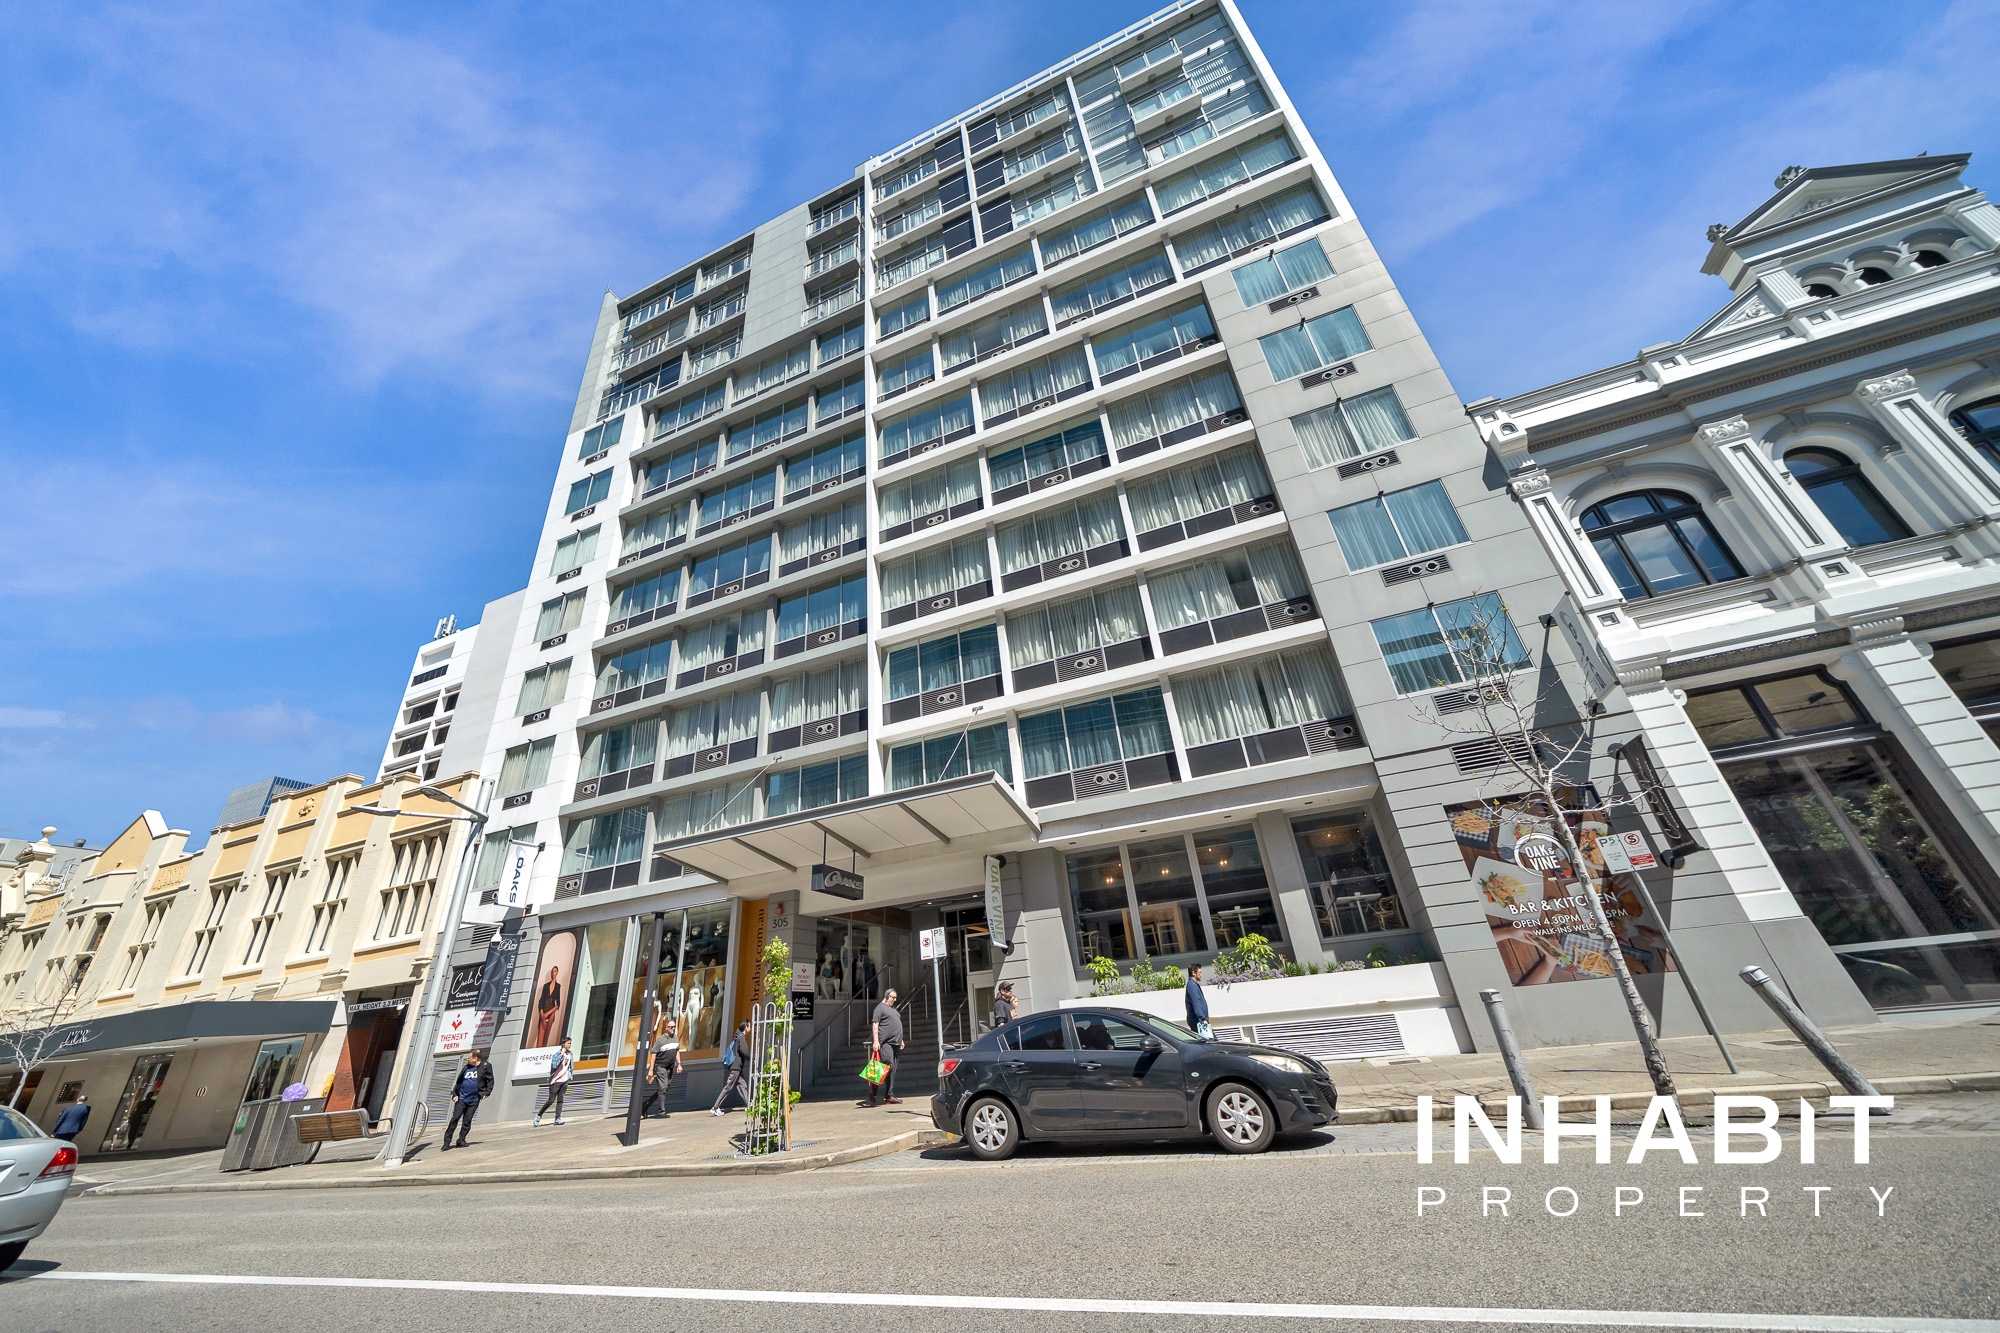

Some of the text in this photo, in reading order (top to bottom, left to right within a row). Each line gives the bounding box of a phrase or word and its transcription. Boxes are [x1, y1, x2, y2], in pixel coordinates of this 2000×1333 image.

[1529, 855, 1561, 871] VINE
[509, 856, 524, 903] OAKS
[831, 873, 863, 890] OAKS
[990, 864, 1001, 896] OAK
[1508, 891, 1619, 915] BAR & KITCEN
[772, 917, 789, 929] 305
[992, 904, 1004, 940] VINE
[1512, 916, 1541, 929] OPEN
[1543, 911, 1582, 926] 4.30PM
[1532, 920, 1616, 937] WALK-INS WELCE
[499, 954, 516, 1006] The Bra Bar
[362, 1001, 382, 1010] HEIGHT
[521, 1055, 539, 1063] SIMONE
